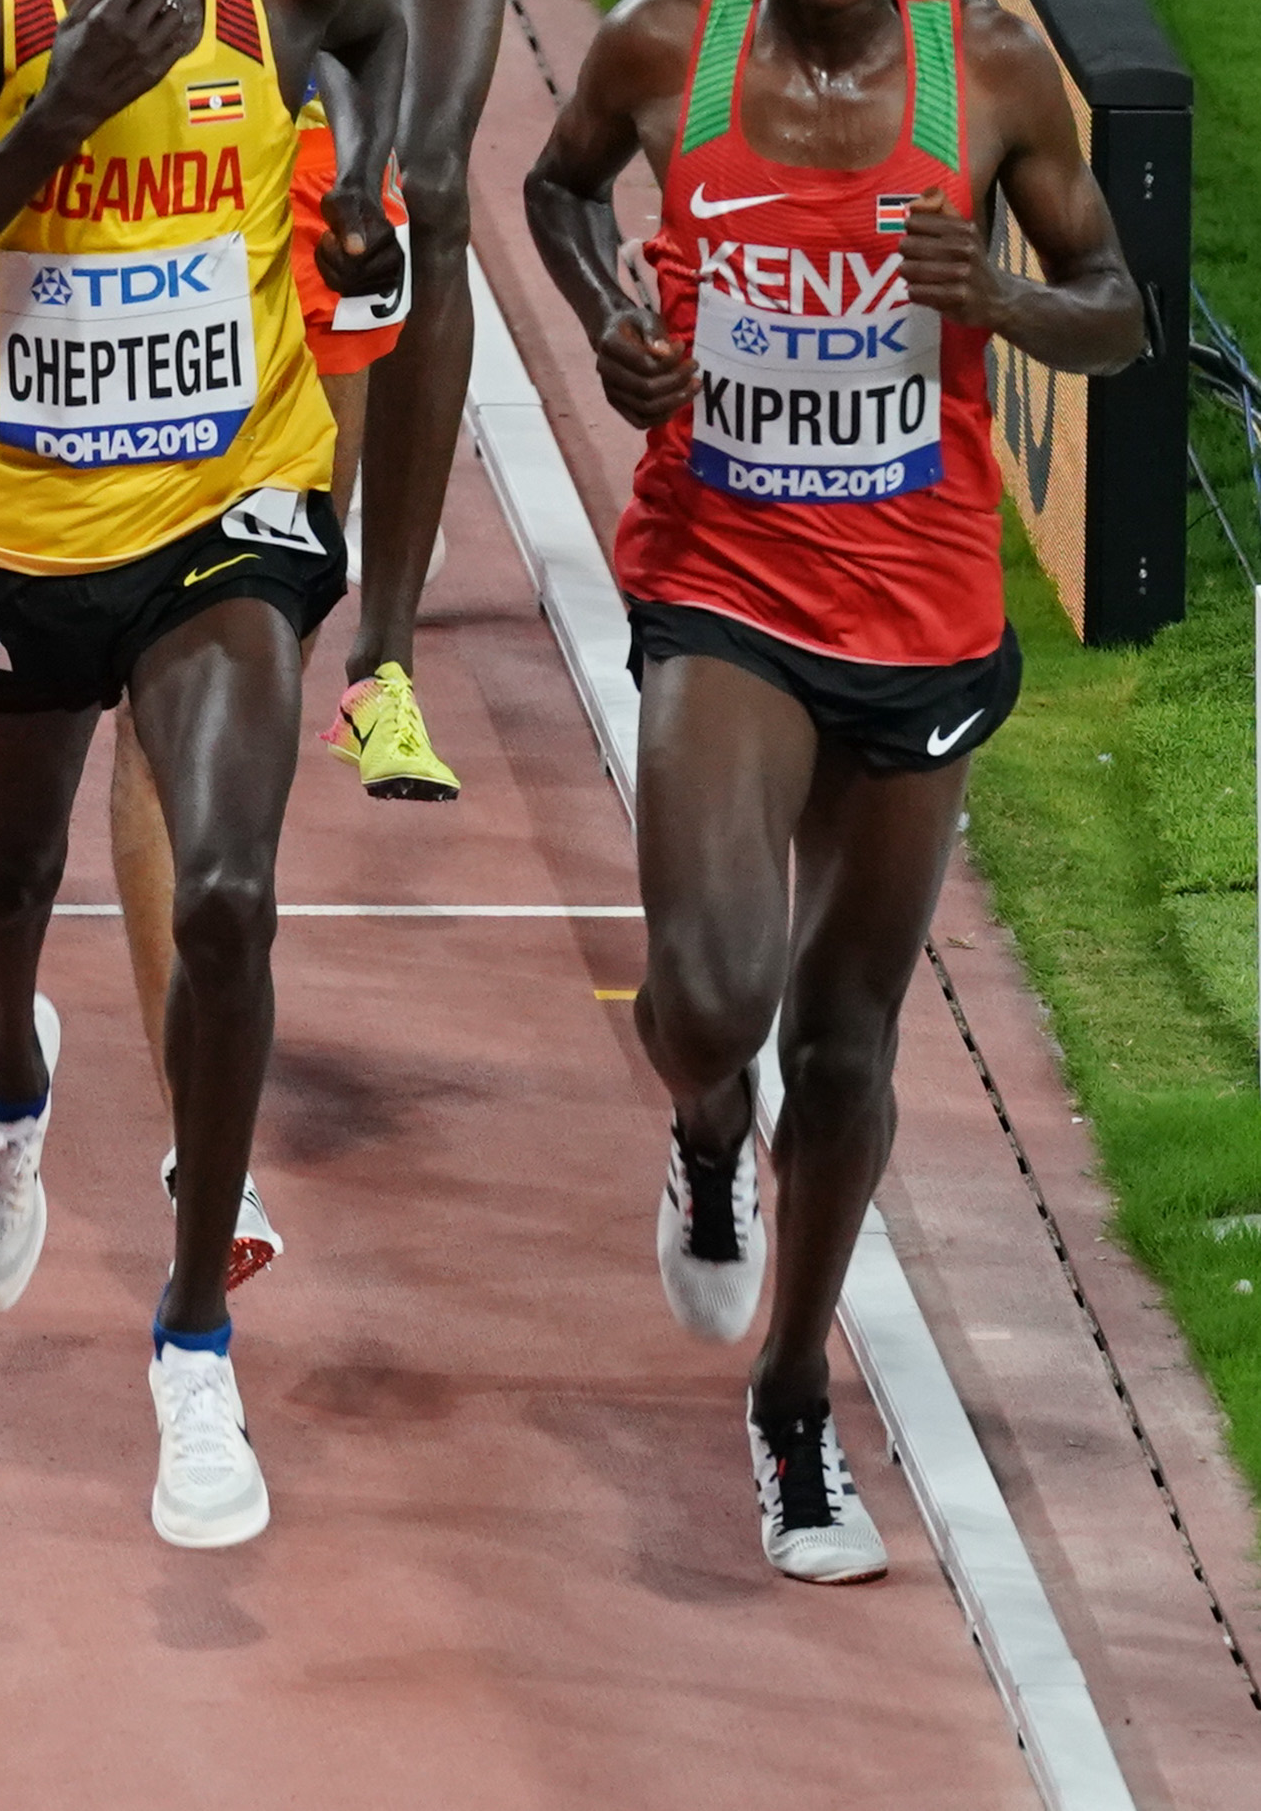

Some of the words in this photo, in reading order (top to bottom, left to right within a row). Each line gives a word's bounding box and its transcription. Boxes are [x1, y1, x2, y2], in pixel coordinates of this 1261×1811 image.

[72, 253, 211, 307] TDK
[769, 317, 909, 360] TDK
[8, 320, 242, 407] CHEPTEGEI
[702, 370, 926, 446] KIPRUTO
[35, 418, 218, 463] DOHA2019
[727, 461, 906, 498] DOHA2019
